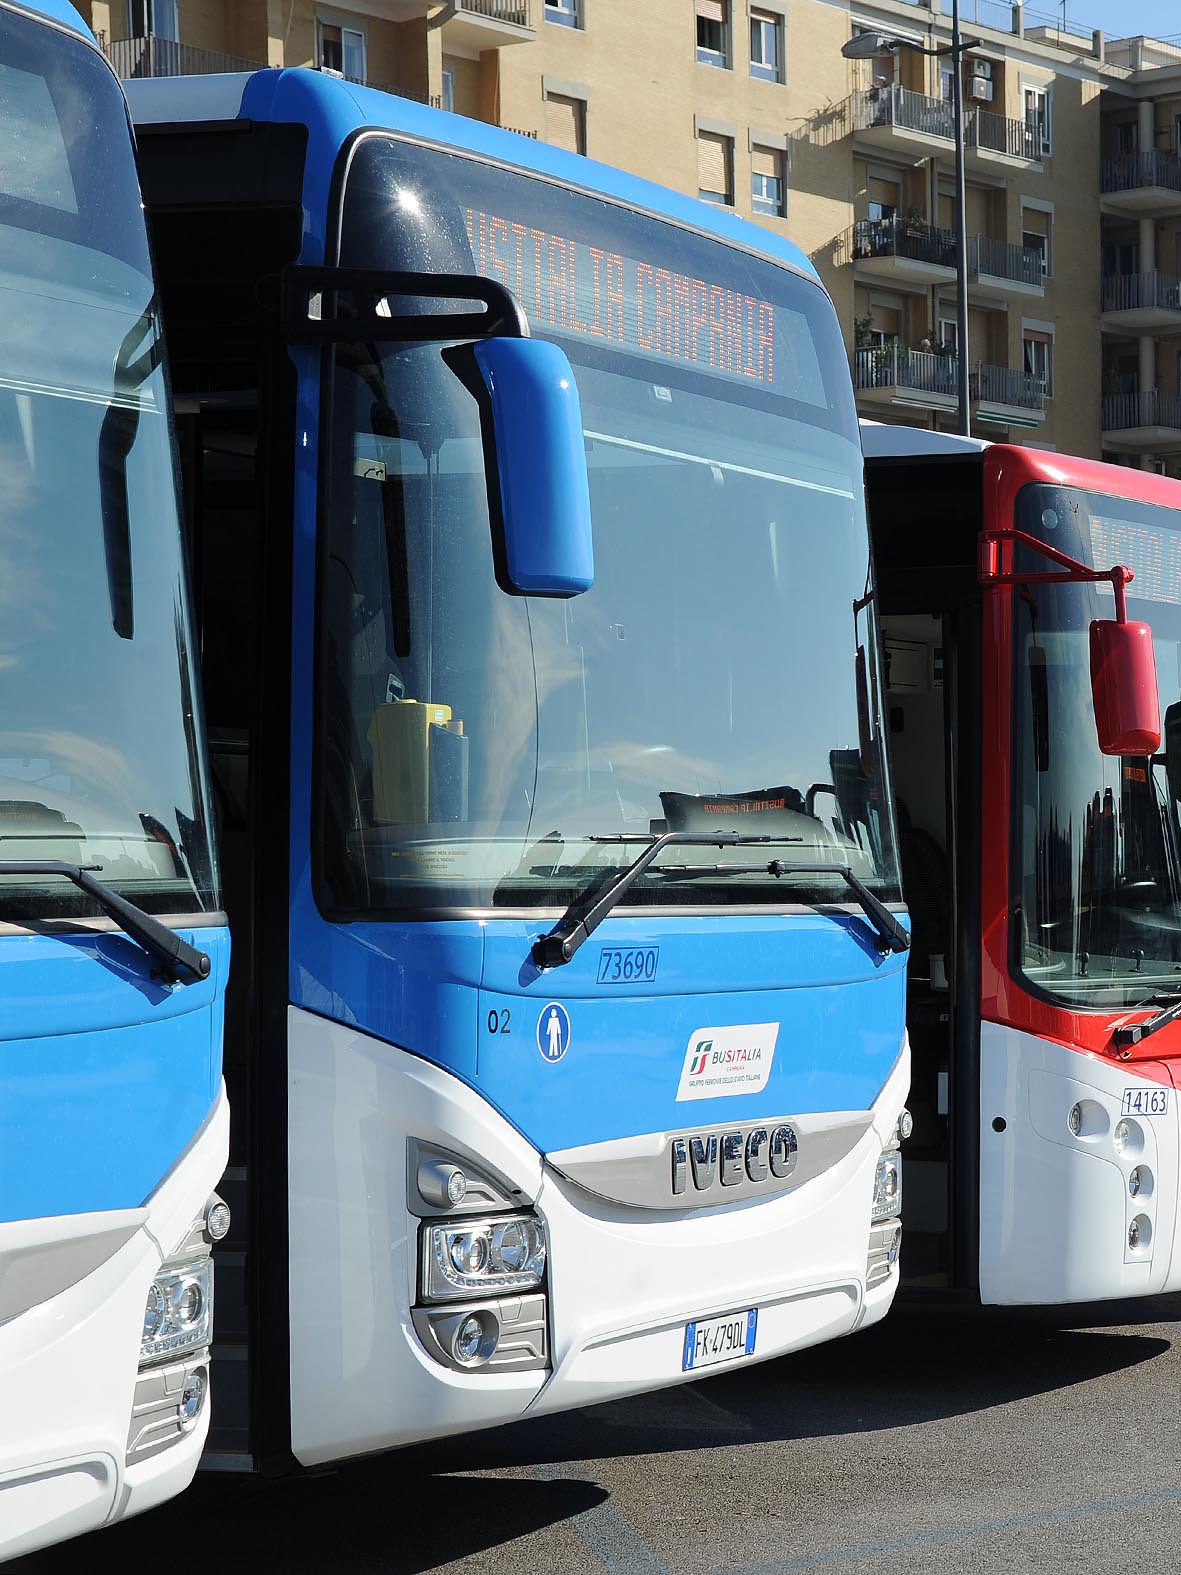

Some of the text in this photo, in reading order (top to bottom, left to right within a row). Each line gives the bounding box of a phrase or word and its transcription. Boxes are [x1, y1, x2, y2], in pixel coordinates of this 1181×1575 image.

[637, 262, 774, 382] CAMPANIA
[600, 949, 655, 981] 73690
[487, 1009, 511, 1034] 02
[711, 1047, 761, 1065] BUSITALIA
[1125, 1090, 1166, 1113] 14163
[671, 1124, 799, 1195] IVECO
